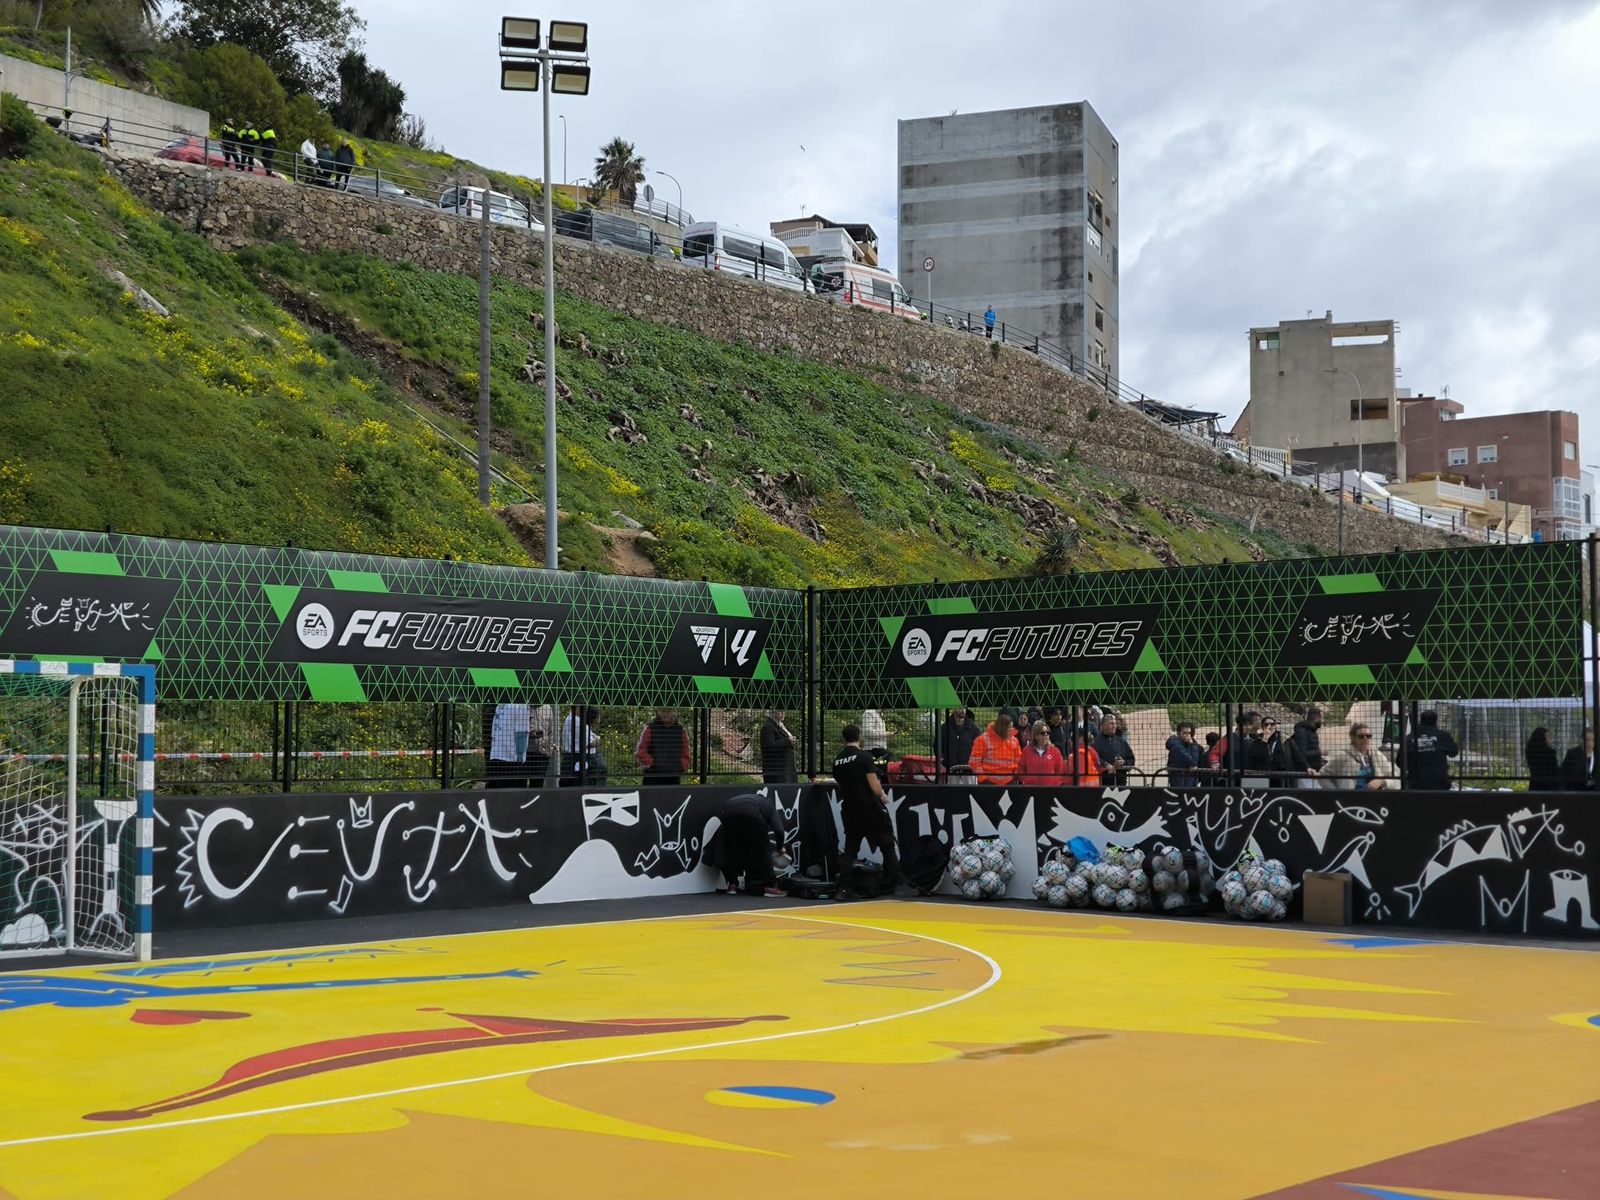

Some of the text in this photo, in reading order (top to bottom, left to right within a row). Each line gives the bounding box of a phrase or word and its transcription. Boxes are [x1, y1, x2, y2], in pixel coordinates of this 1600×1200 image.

[303, 613, 327, 629] EA
[303, 629, 328, 637] SPORTS
[908, 636, 926, 649] EA
[834, 754, 858, 767] STAFF
